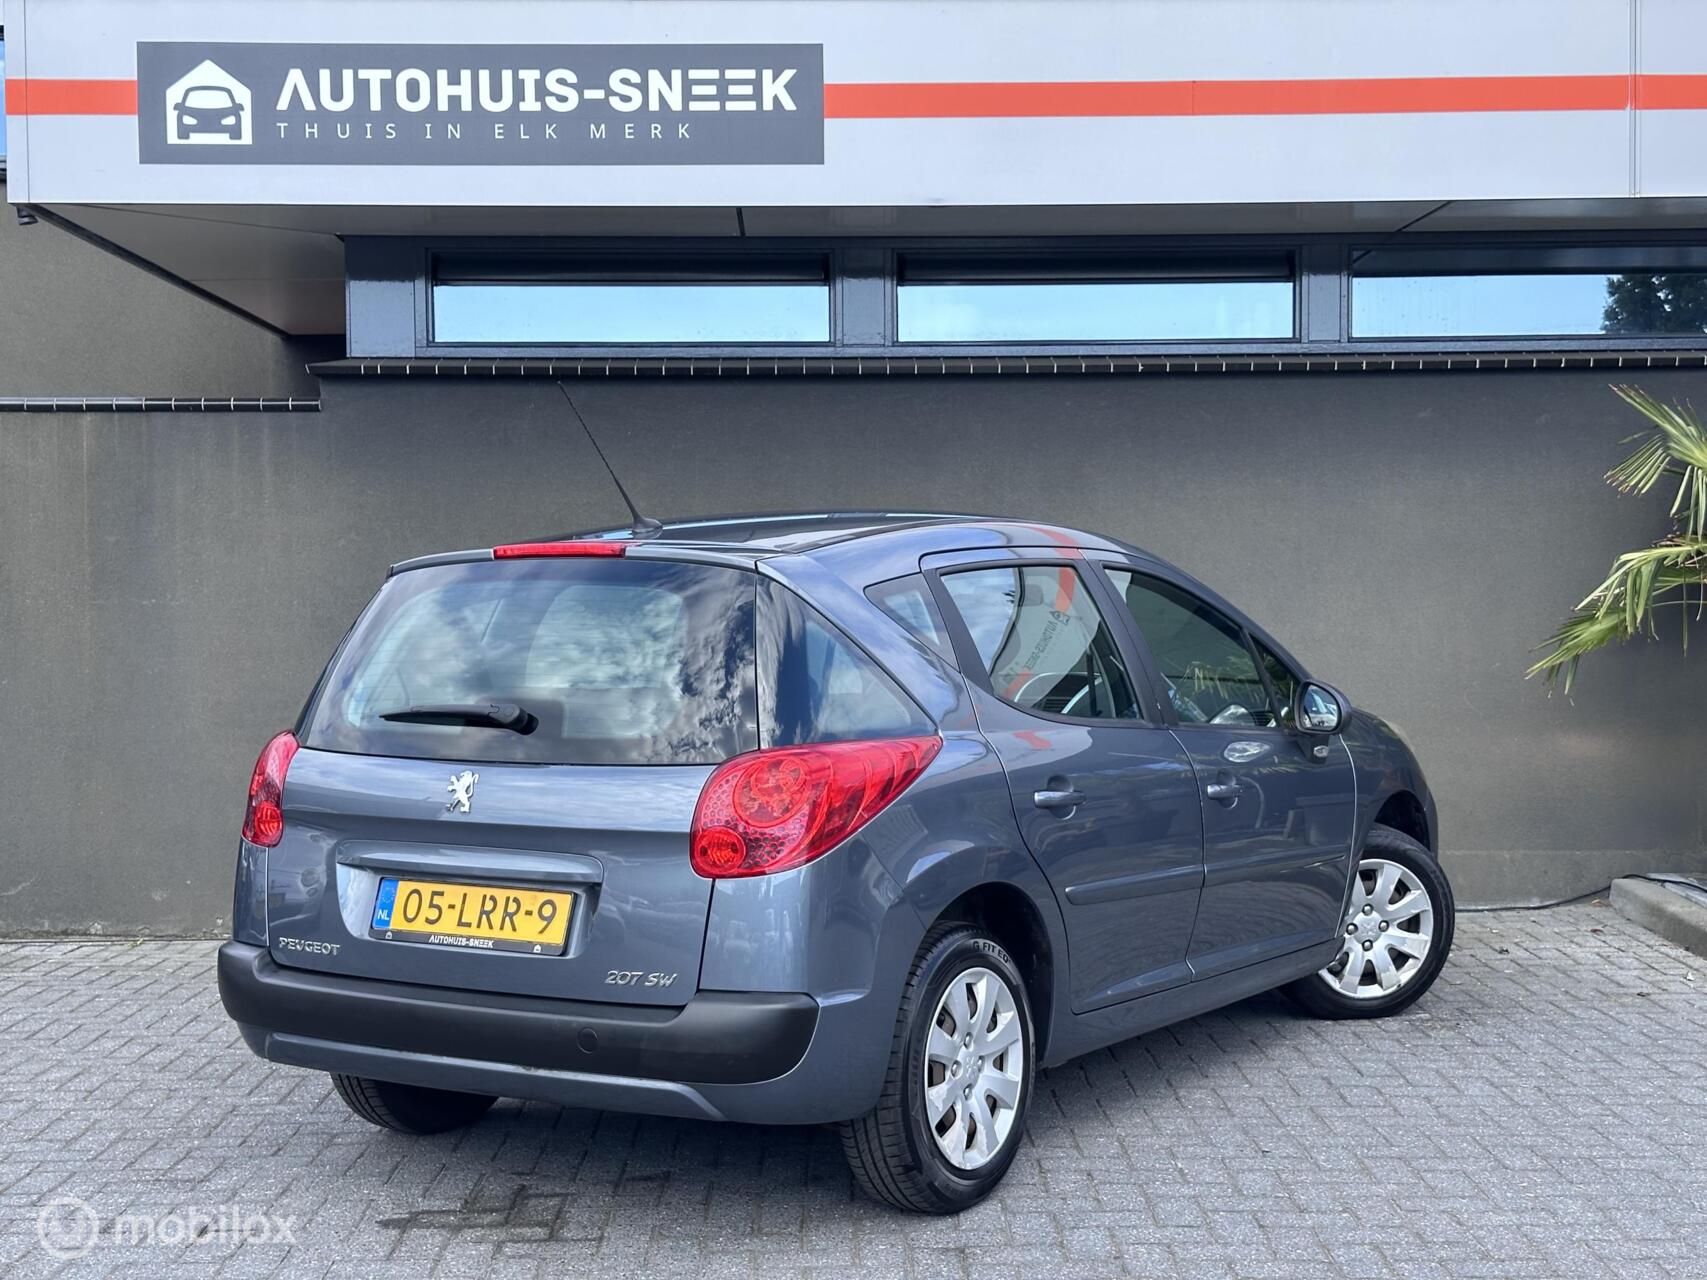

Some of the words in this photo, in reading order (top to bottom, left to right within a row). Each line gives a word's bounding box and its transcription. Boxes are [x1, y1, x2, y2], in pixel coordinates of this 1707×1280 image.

[276, 67, 798, 113] AUTOHUIS-SNEEK
[276, 123, 398, 139] THUIS
[425, 123, 463, 139] IN
[495, 123, 558, 139] ELK
[590, 124, 691, 140] MERK
[377, 909, 390, 921] NL
[402, 888, 558, 935] 05-LRR-9
[279, 937, 340, 956] PEUGEOT
[429, 934, 494, 949] AUTOHUIS-SNEEK
[604, 970, 644, 986] 207
[644, 972, 678, 987] SW
